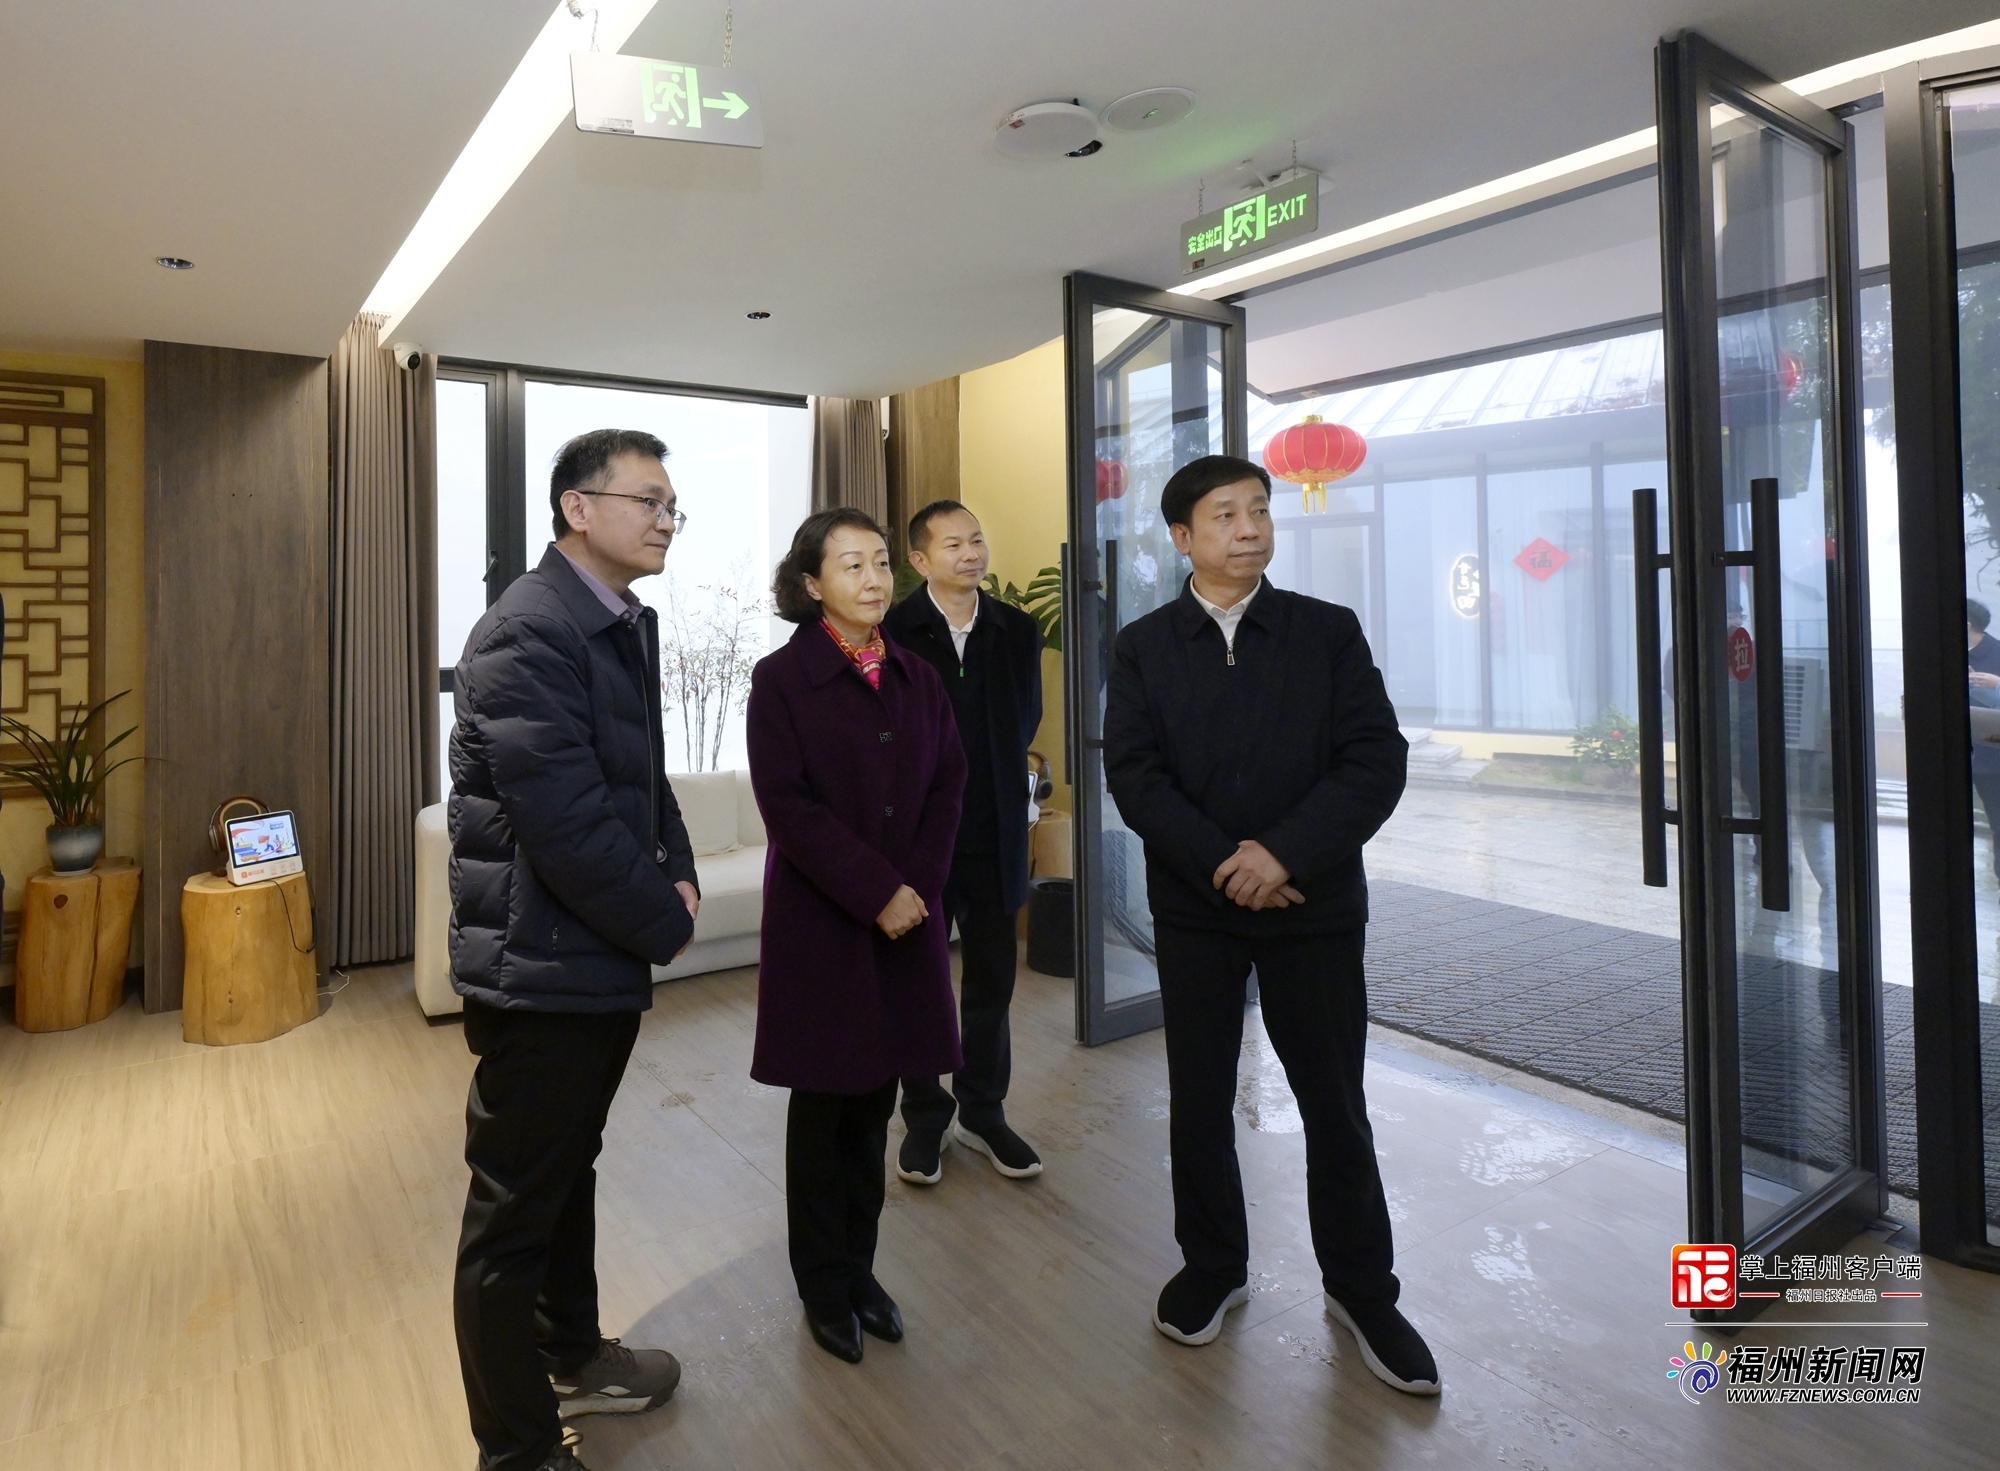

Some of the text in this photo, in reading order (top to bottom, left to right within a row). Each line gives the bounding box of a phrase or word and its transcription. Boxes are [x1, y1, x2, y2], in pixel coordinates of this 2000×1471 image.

[1267, 194, 1307, 227] EXIT
[1188, 225, 1223, 256] 安全出口
[1734, 637, 1750, 673] 拉
